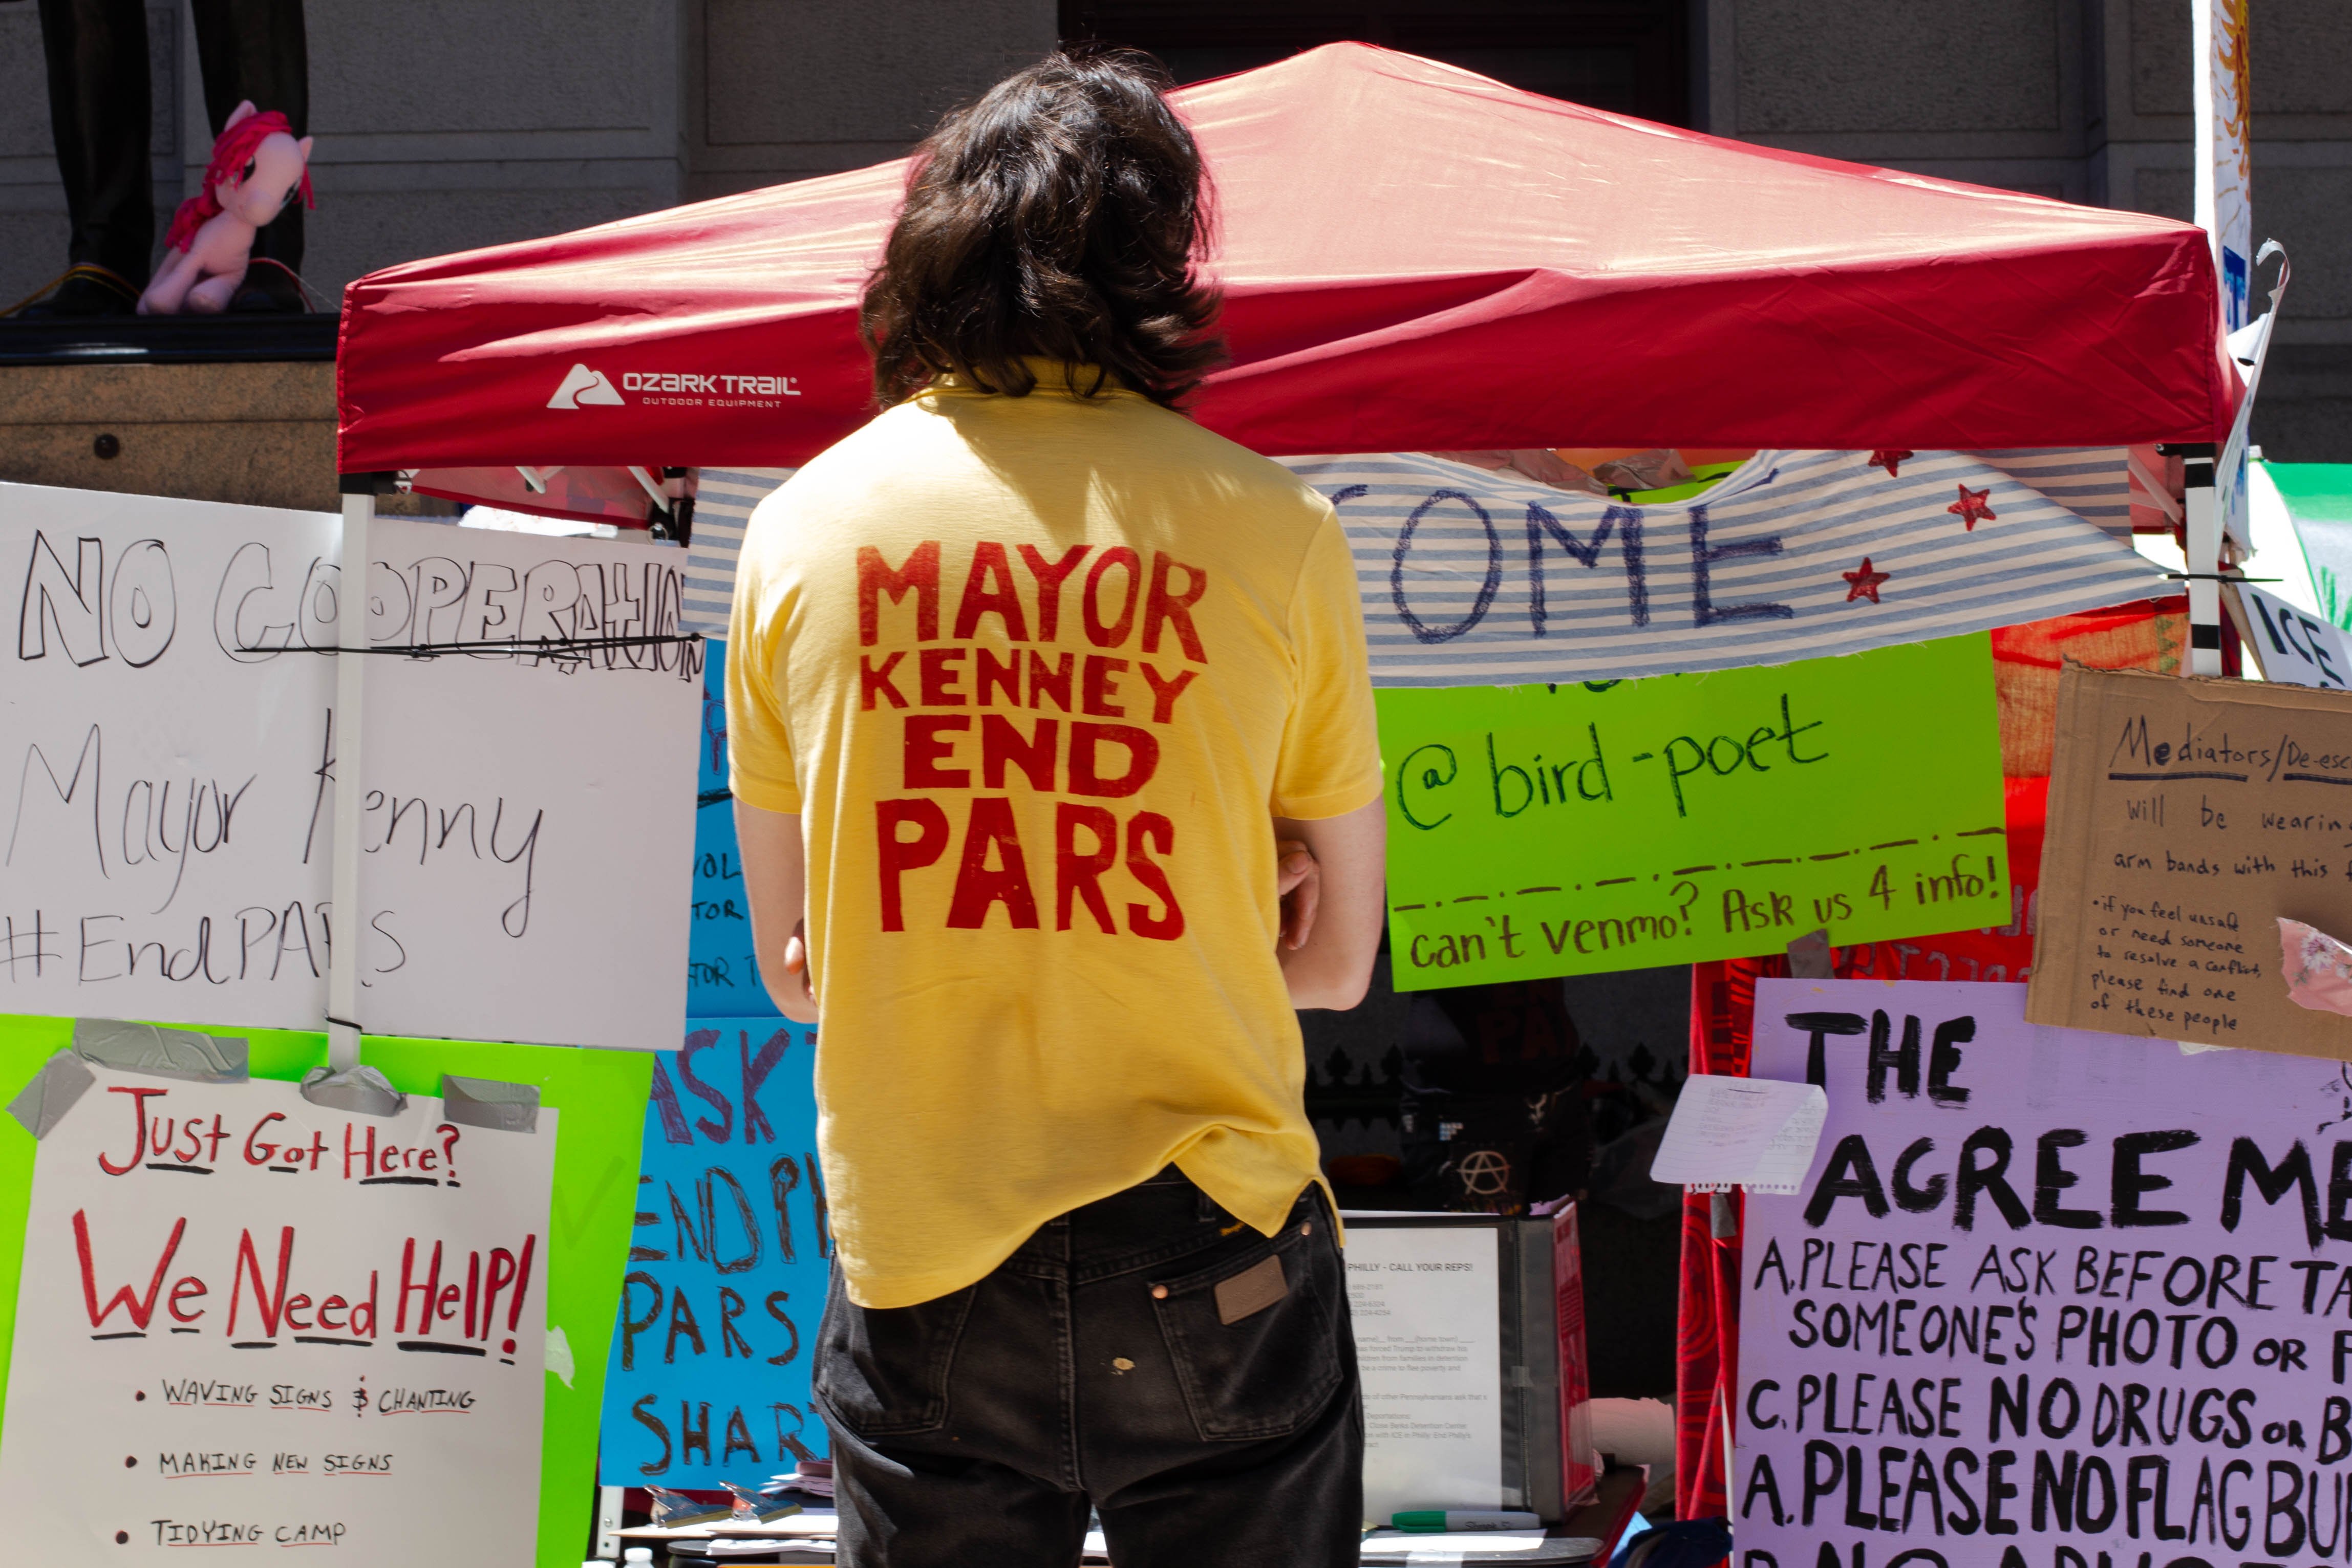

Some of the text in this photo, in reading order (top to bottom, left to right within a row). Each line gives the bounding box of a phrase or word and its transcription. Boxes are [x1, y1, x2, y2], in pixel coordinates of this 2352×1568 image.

[623, 373, 717, 393] OZARK
[643, 397, 781, 408] OUTDOOR EQUIPMENT
[19, 529, 177, 668] NO
[1331, 483, 1794, 645] OME
[857, 541, 1209, 664] MAYOR
[2250, 593, 2346, 687] ICE
[860, 647, 1200, 724] KENNEY
[903, 714, 1159, 798] END
[6, 723, 257, 914] Mayor
[2201, 794, 2228, 830] be
[2261, 812, 2352, 848] wearin
[875, 797, 1185, 940] PARS
[2114, 852, 2152, 869] arm
[2166, 849, 2219, 876] bands
[2234, 854, 2276, 873] with
[2291, 857, 2328, 878] this
[1410, 853, 1999, 968] can't venmo? Ask us 4 info!
[2100, 927, 2244, 954] or need someone
[2121, 904, 2146, 921] you
[2150, 901, 2181, 921] feel
[2091, 970, 2237, 1001] please find one
[2097, 945, 2111, 958] to
[2124, 951, 2177, 967] resolve
[2189, 960, 2199, 970] a
[2090, 993, 2237, 1035] of these people
[1784, 1008, 1977, 1110] THE
[98, 1086, 460, 1180] Just Got Here?
[72, 1209, 207, 1329] We
[226, 1226, 378, 1339] Need
[1388, 1263, 1413, 1271] CALL
[1416, 1263, 1443, 1271] YOUR
[1970, 1244, 2056, 1296] ASK
[2075, 1245, 2279, 1311] BEFORE
[621, 1271, 800, 1372] PARS
[2055, 1304, 2238, 1370] PHOTO
[2253, 1338, 2308, 1372] OR
[162, 1380, 258, 1405] WAVING
[270, 1384, 332, 1408] SIGNS
[379, 1388, 476, 1413] CHANTING
[632, 1393, 833, 1476] SHAR
[1988, 1373, 2081, 1443] NO
[2092, 1382, 2256, 1449] DRUGS
[159, 1452, 393, 1474] MAKING NEW SIGNS
[151, 1519, 347, 1546] TIDYING CAMP
[2126, 1454, 2253, 1552] FLAG
[2264, 1460, 2352, 1564] BU
